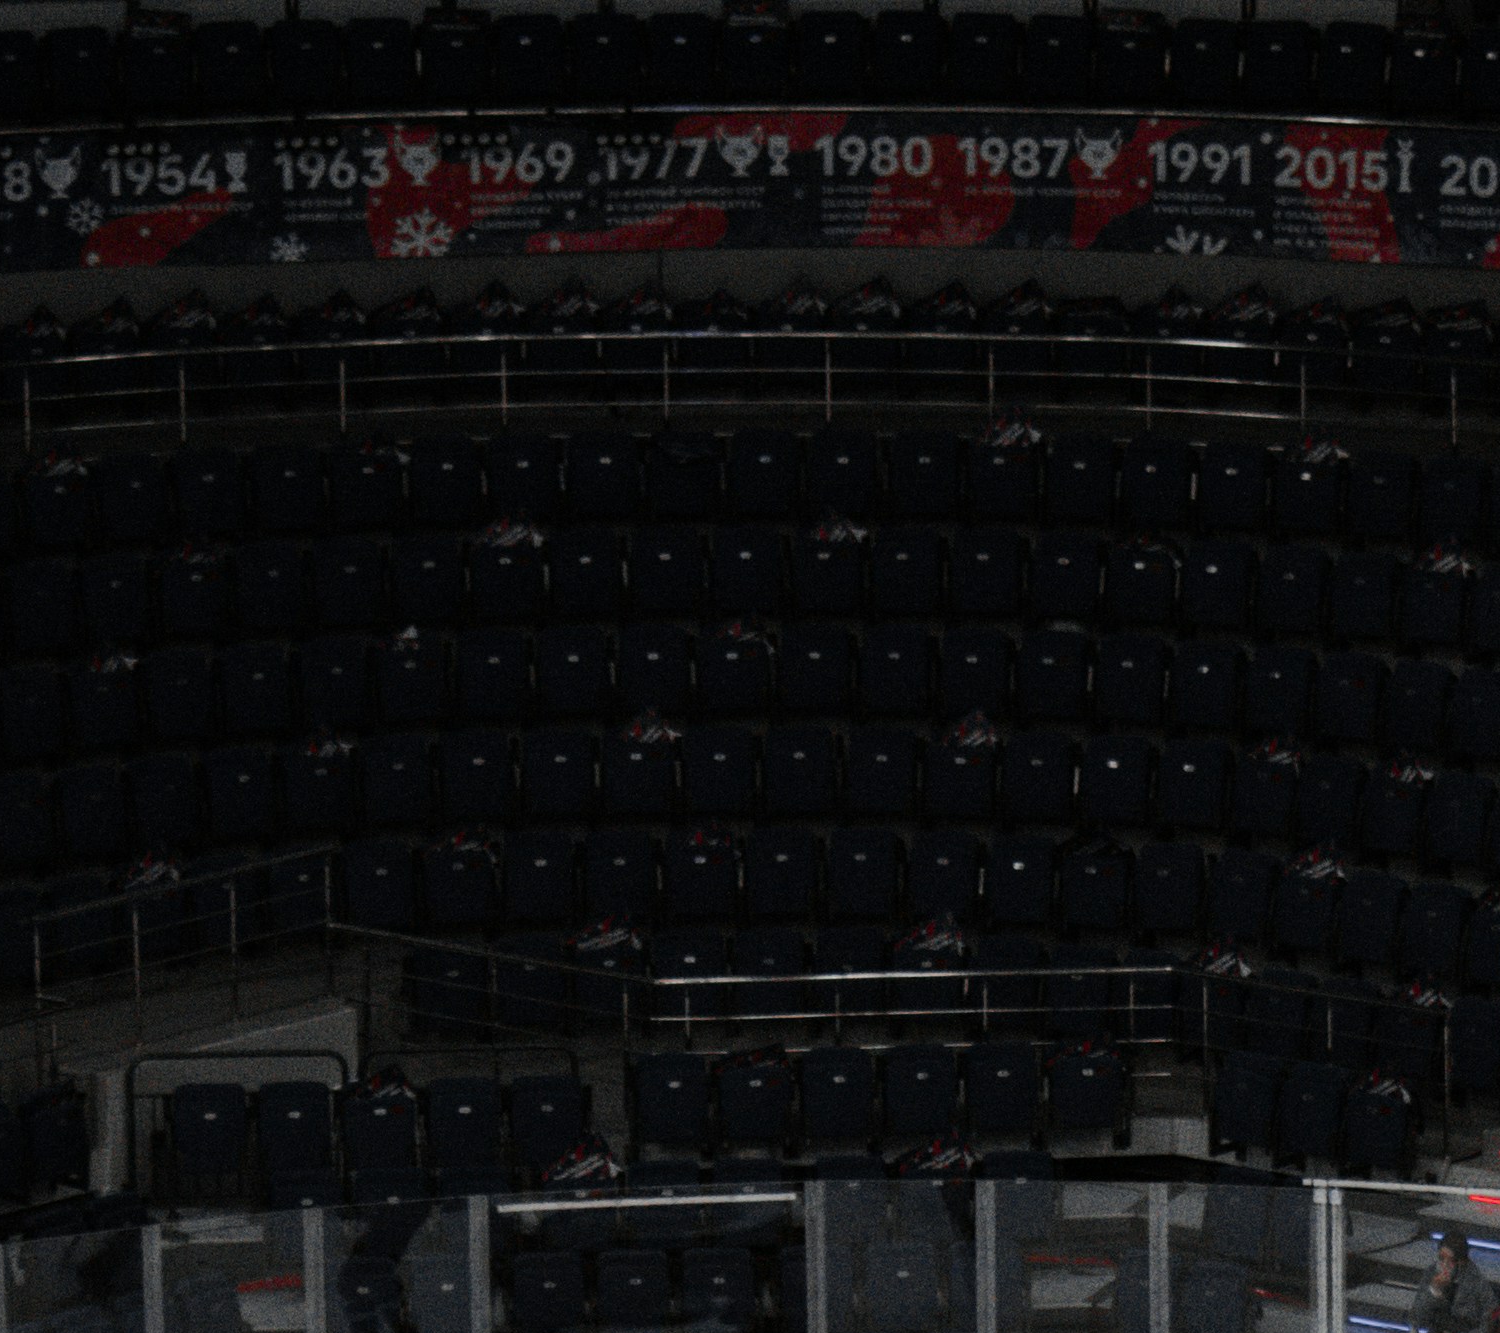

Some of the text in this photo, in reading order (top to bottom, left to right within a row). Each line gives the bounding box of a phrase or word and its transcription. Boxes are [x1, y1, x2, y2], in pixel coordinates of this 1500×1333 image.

[101, 150, 218, 198] 1954
[274, 147, 391, 191] 1963
[459, 142, 576, 187] 1969
[813, 134, 934, 179] 1980
[957, 135, 1071, 180] 1987
[1148, 140, 1253, 187] 1991
[1273, 144, 1390, 193] 2015
